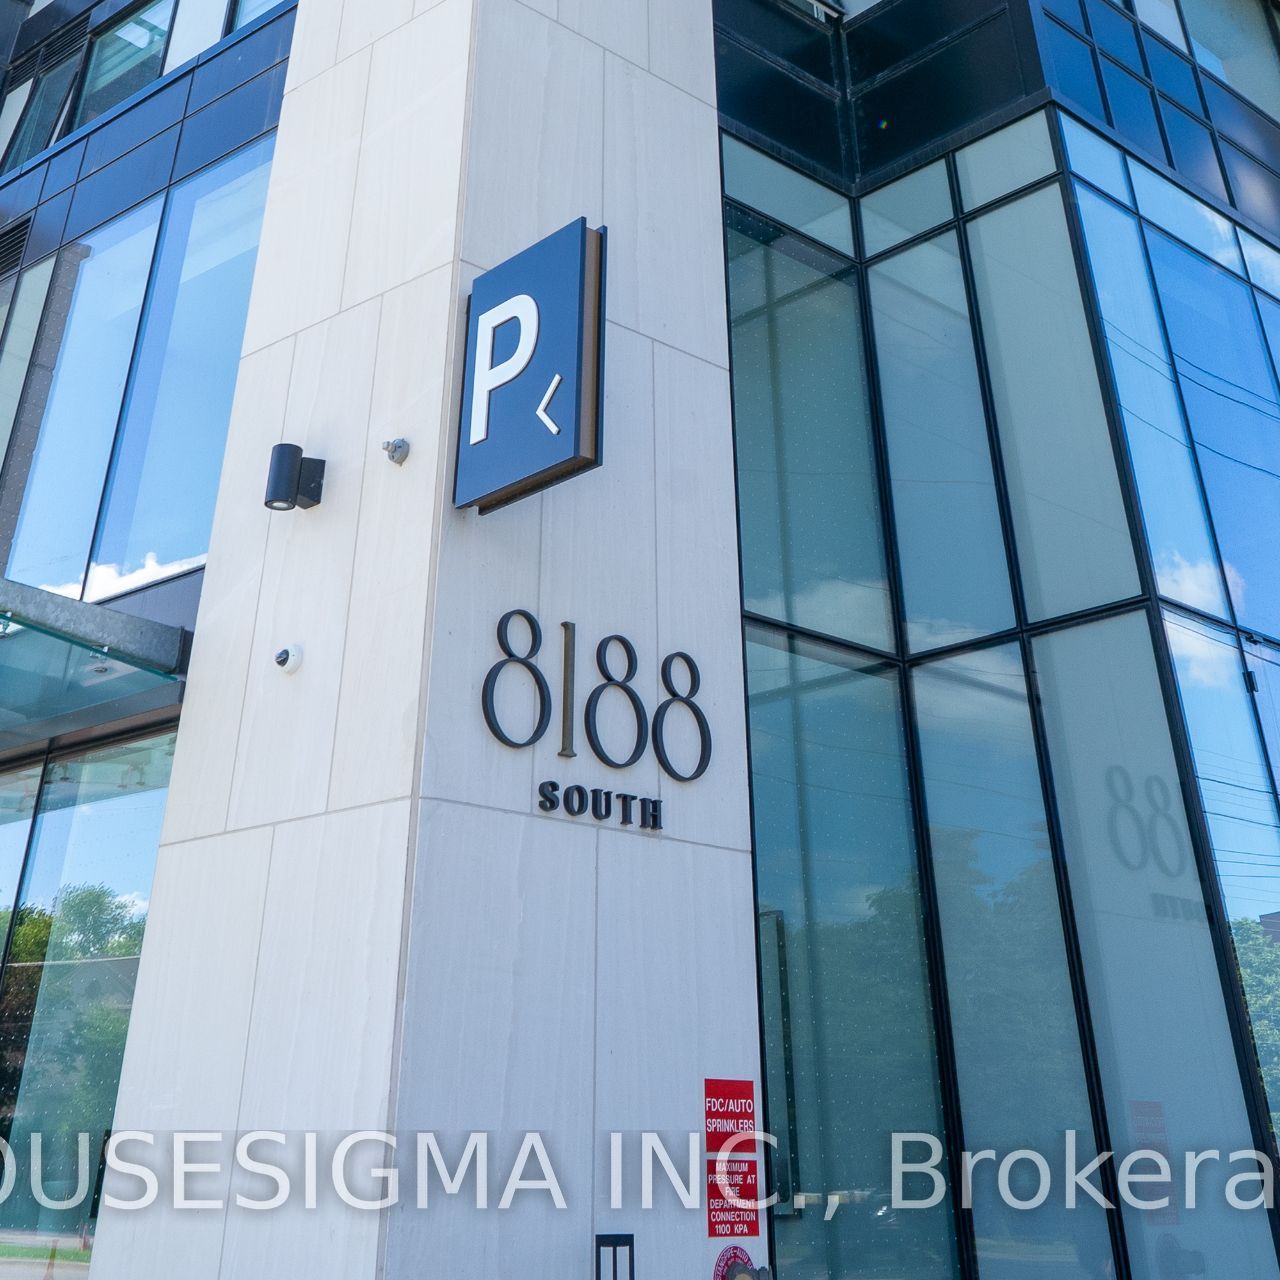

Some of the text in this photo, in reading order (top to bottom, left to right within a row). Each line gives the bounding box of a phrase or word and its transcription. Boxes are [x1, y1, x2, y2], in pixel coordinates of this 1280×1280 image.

[468, 293, 539, 446] P
[481, 609, 713, 783] 8188
[538, 780, 663, 830] SOUTH
[705, 1097, 754, 1113] FDC/AUTO
[706, 1118, 755, 1133] SPRINKLERS
[716, 1162, 748, 1172] MAXIMUM
[708, 1174, 756, 1184] PRESSURE AT
[724, 1186, 740, 1197] FIRE
[709, 1198, 756, 1209] DEPARTMENT
[710, 1211, 756, 1221] CONNECTION
[715, 1223, 749, 1235] 1100 KPA
